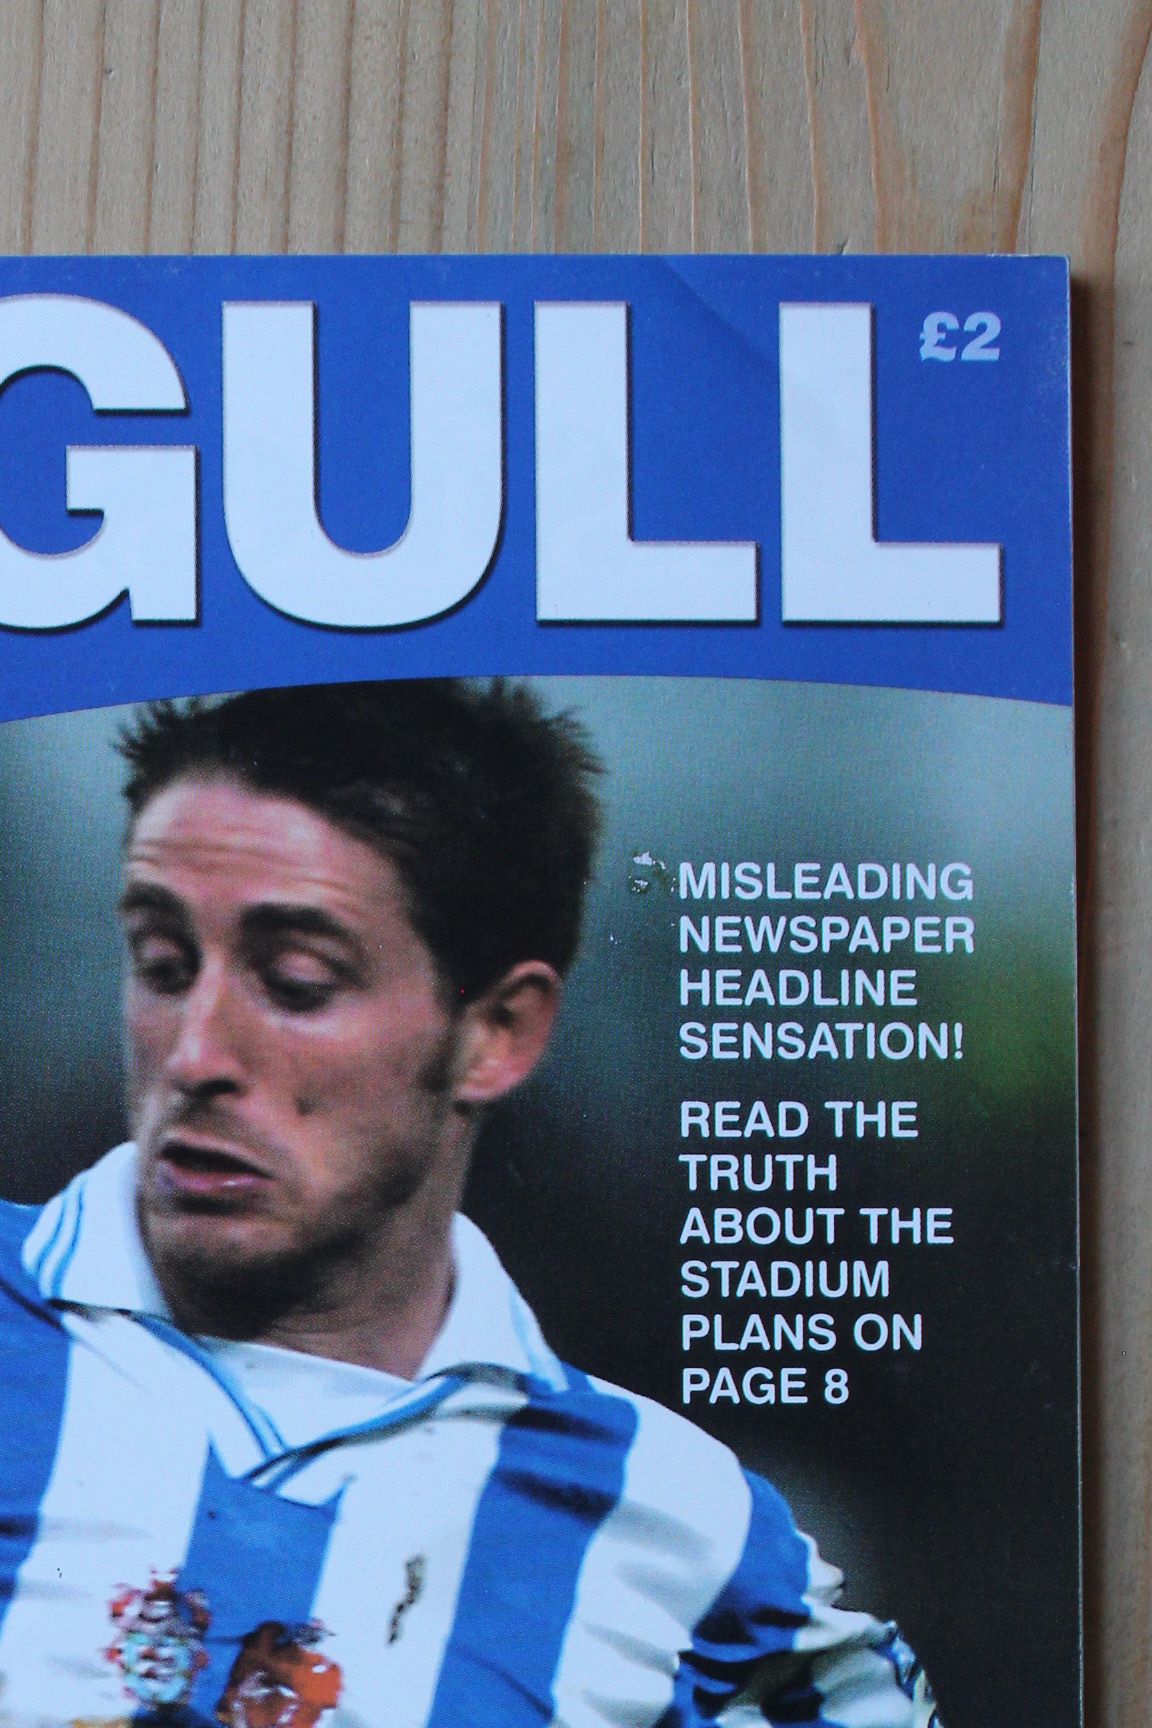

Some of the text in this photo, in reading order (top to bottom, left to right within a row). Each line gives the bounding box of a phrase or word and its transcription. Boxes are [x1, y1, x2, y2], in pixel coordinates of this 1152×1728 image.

[919, 310, 1002, 361] £2
[679, 862, 974, 900] MISLEADING
[679, 916, 975, 953] NEWSPAPER
[680, 969, 918, 1006] HEADLINE
[679, 1021, 964, 1060] SENSATION!
[681, 1100, 919, 1138] READ THE
[678, 1153, 838, 1192] TRUTH
[679, 1206, 955, 1245] ABOUT THE
[681, 1259, 890, 1298] STADIUM
[682, 1313, 923, 1351] PLANS ON
[682, 1366, 850, 1405] PAGE 8
